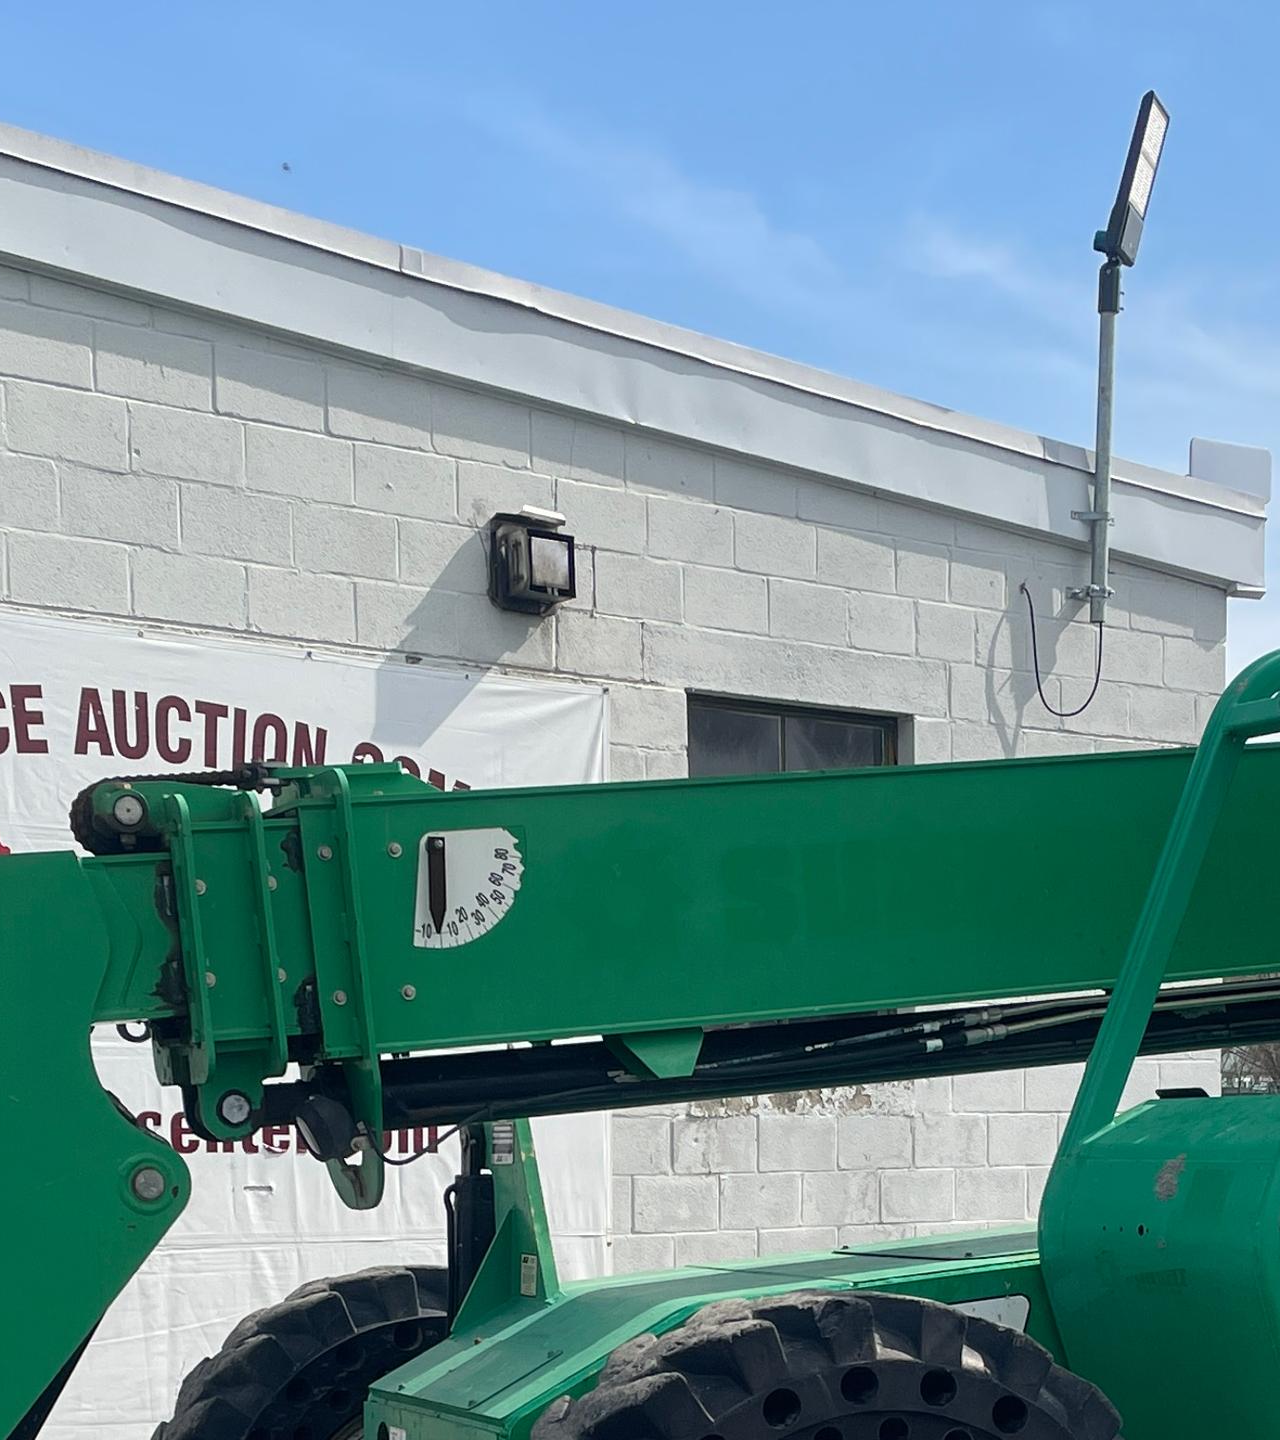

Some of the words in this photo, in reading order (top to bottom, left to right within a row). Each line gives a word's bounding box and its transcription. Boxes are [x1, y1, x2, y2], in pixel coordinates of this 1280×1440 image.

[74, 687, 327, 769] AUCTION
[494, 848, 509, 860] 80
[502, 862, 516, 876] 70
[488, 872, 504, 887] 60
[475, 892, 490, 908] 40
[489, 889, 505, 905] 50
[455, 906, 468, 923] 20
[470, 909, 485, 926] 30
